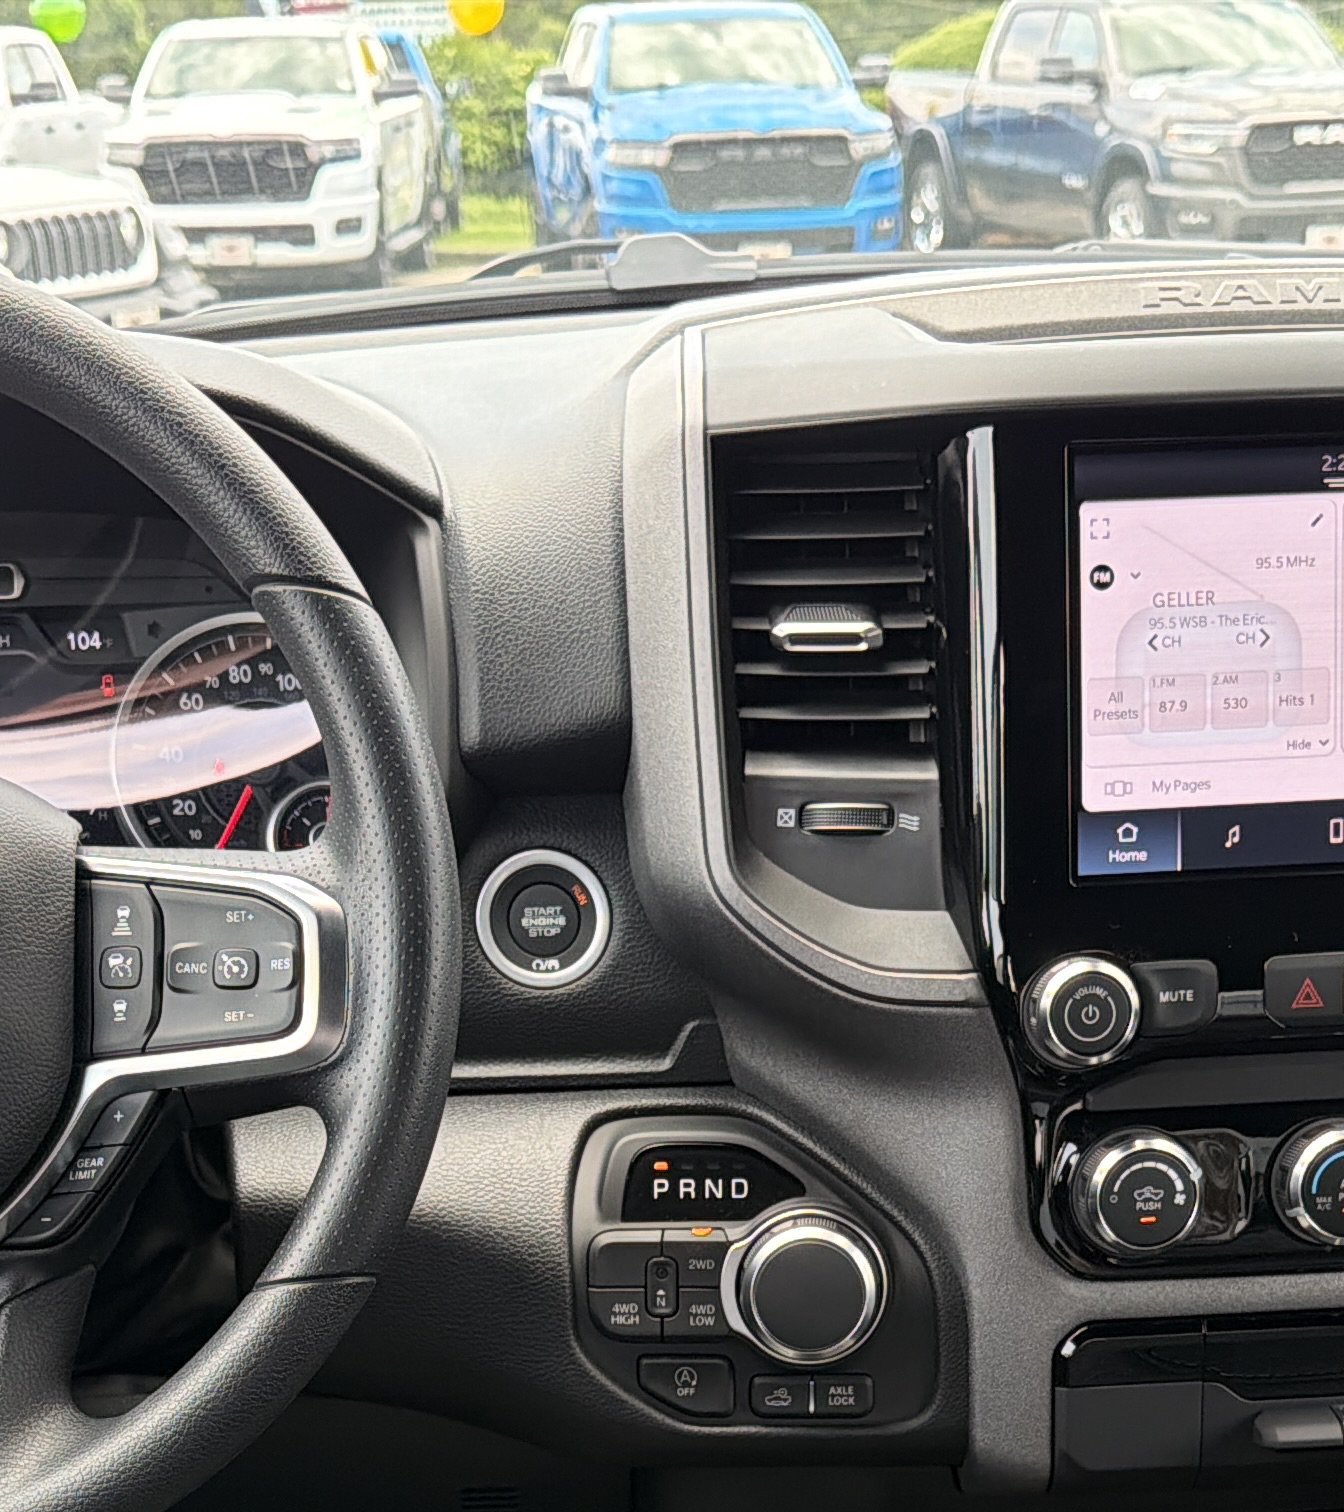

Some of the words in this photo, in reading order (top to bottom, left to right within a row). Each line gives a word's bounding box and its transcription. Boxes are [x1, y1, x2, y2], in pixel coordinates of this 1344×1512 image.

[1138, 277, 1342, 309] RAM
[1255, 556, 1283, 570] 95.5
[1286, 555, 1316, 568] MHz
[1092, 570, 1112, 584] FM
[1152, 590, 1216, 609] GELLER
[1148, 617, 1177, 630] 95.5
[1179, 616, 1208, 629] WSB
[1217, 613, 1241, 628] The
[66, 630, 102, 650] 104
[1161, 635, 1182, 649] CH
[1235, 632, 1256, 645] CH
[228, 664, 252, 684] 80
[258, 662, 274, 676] 90
[206, 675, 220, 689] 70
[179, 692, 204, 712] 60
[1108, 690, 1124, 705] All
[1223, 697, 1248, 710] 530
[1278, 694, 1305, 706] Hits
[1158, 700, 1188, 713] 87.9
[1093, 708, 1139, 722] Presets
[1286, 739, 1312, 751] Hide
[1151, 780, 1171, 795] My
[1173, 778, 1212, 794] Pages
[172, 799, 197, 817] 20
[188, 828, 203, 841] 10
[1108, 849, 1148, 863] Home
[570, 883, 590, 907] RUN
[524, 906, 563, 918] START
[521, 915, 567, 928] ENGINE
[528, 927, 561, 938] STOP
[175, 962, 208, 974] CANC
[270, 958, 291, 971] RES
[1072, 984, 1109, 1001] VOLUME
[1159, 989, 1194, 1003] MUTE
[76, 1156, 105, 1169] GEAR
[69, 1168, 97, 1181] LIMIT
[1135, 1201, 1162, 1211] PUSH
[688, 1258, 715, 1270] 2WD
[611, 1302, 639, 1315] 4WD
[656, 1296, 666, 1308] N
[688, 1303, 716, 1316] 4WD
[610, 1313, 640, 1326] HIGH
[689, 1314, 716, 1327] LOW
[676, 1386, 696, 1397] OFF
[828, 1385, 855, 1396] AXLE
[828, 1395, 856, 1407] LOCK
